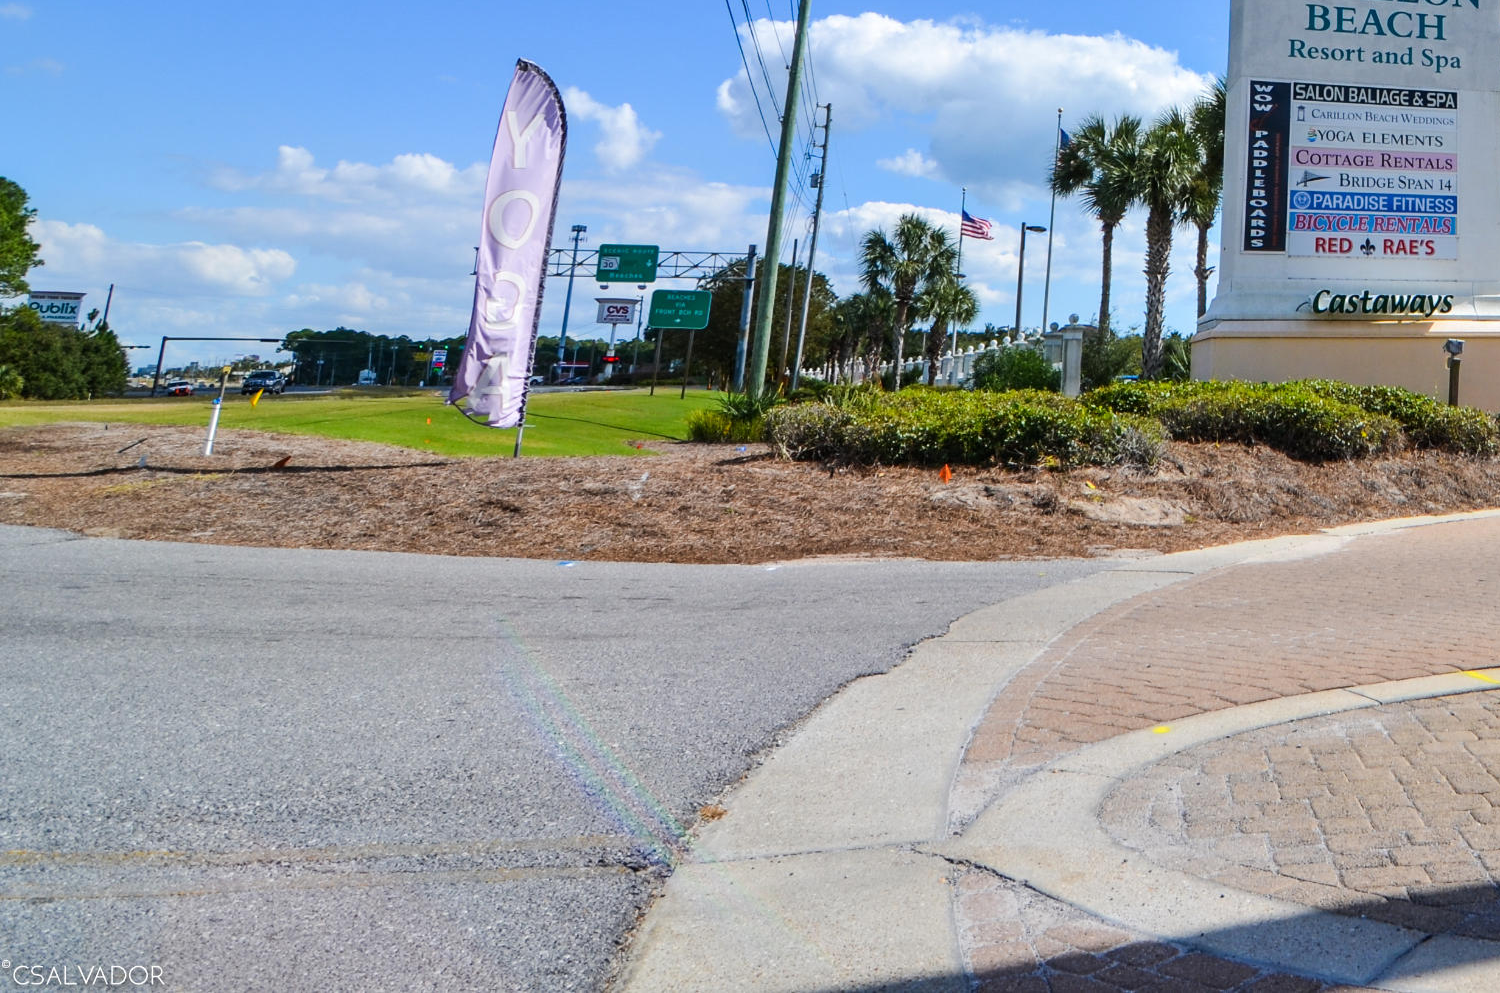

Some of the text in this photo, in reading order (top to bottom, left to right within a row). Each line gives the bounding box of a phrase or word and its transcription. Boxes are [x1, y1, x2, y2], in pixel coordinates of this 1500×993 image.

[1304, 4, 1448, 41] BEACH
[1288, 39, 1461, 73] Resort and Spa
[1295, 84, 1455, 108] SALON BALIAGE & SPA
[1311, 108, 1454, 126] CARILLON BEACH WEDDINGS
[1317, 129, 1443, 147] YOGA ELEMENTS
[1250, 84, 1274, 247] WOW PADDLEBOARDS
[1296, 149, 1453, 170] COTTAGE RENTALS
[1339, 173, 1452, 191] BRIDGE SPAN 14
[1314, 194, 1455, 213] PARADISE FITNESS
[1294, 214, 1452, 234] BICYCLE RENTALS
[1315, 237, 1435, 256] RED RAE'S
[607, 306, 629, 314] CVS
[1312, 289, 1454, 317] Castaways
